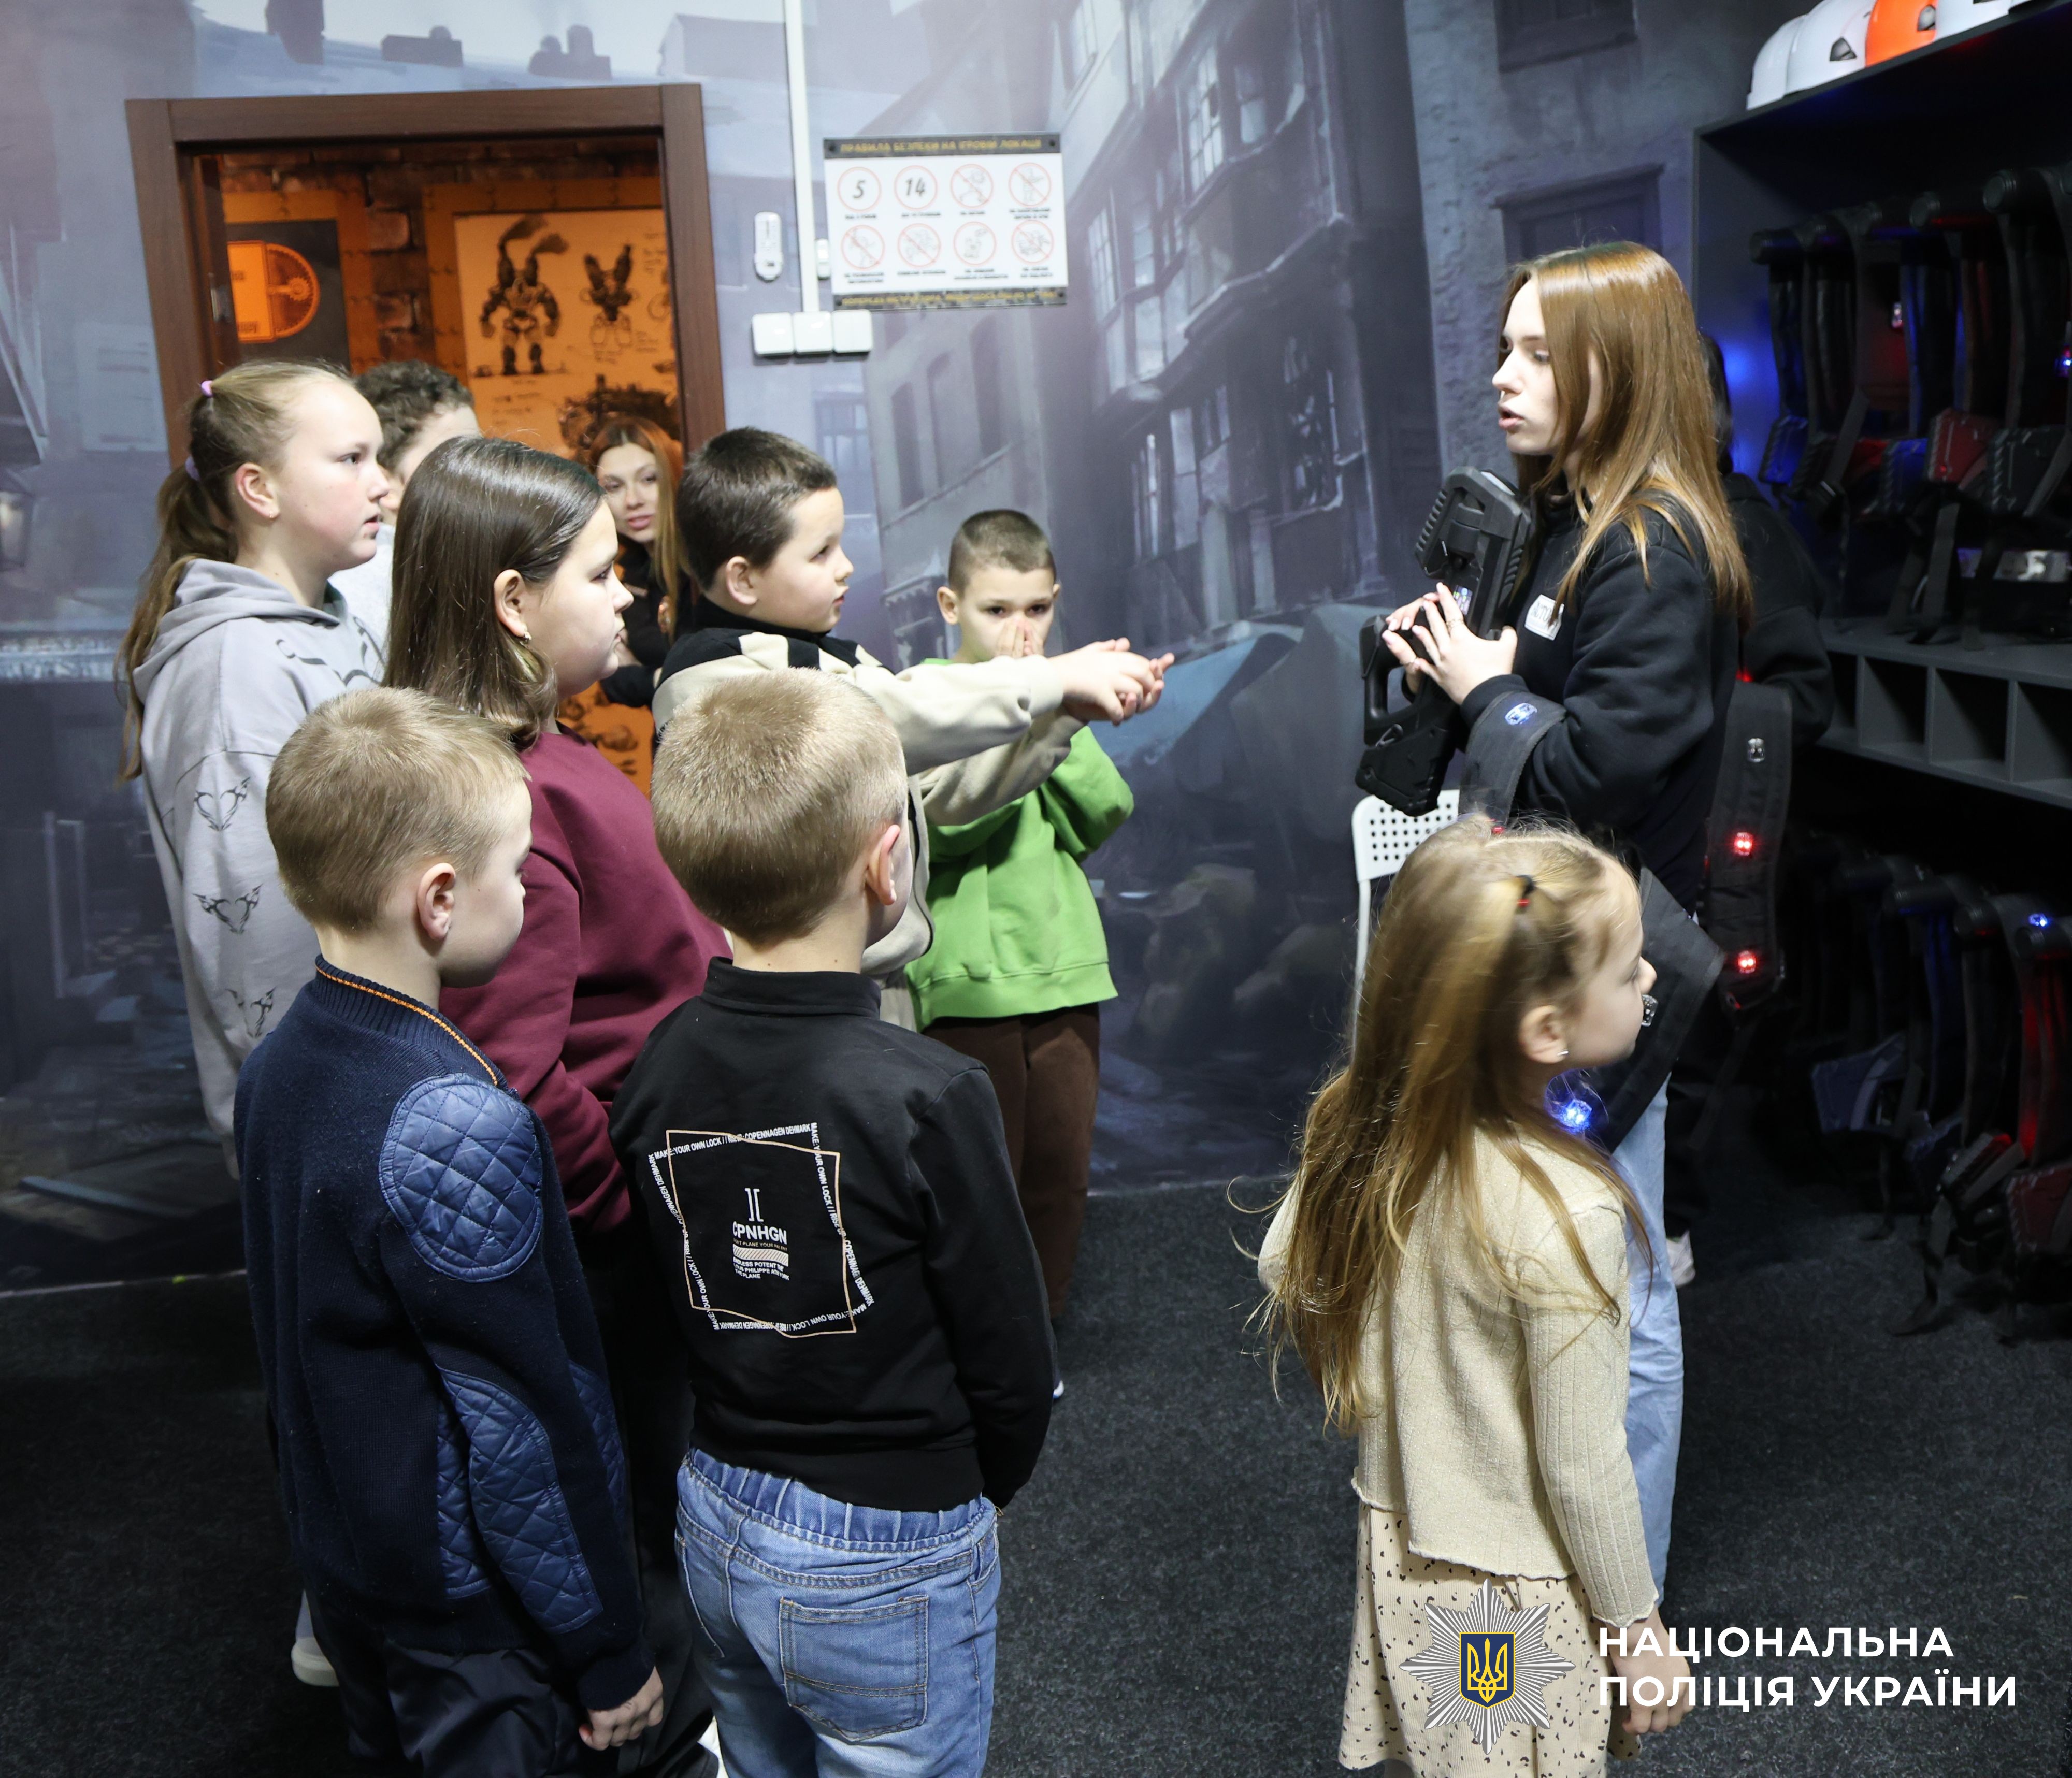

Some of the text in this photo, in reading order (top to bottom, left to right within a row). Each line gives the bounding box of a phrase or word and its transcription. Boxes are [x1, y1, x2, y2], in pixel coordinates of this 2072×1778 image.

[852, 179, 866, 199] 5
[905, 178, 926, 197] 14
[690, 1141, 706, 1151] OWN
[706, 1137, 722, 1148] LOCK
[817, 1166, 828, 1185] OWN
[821, 1185, 833, 1206] LOCK
[732, 1221, 787, 1245] CPNHGN
[688, 1262, 701, 1279] LOCK
[696, 1278, 707, 1294] OWN
[792, 1321, 811, 1331] LOCK
[811, 1314, 827, 1325] OWN
